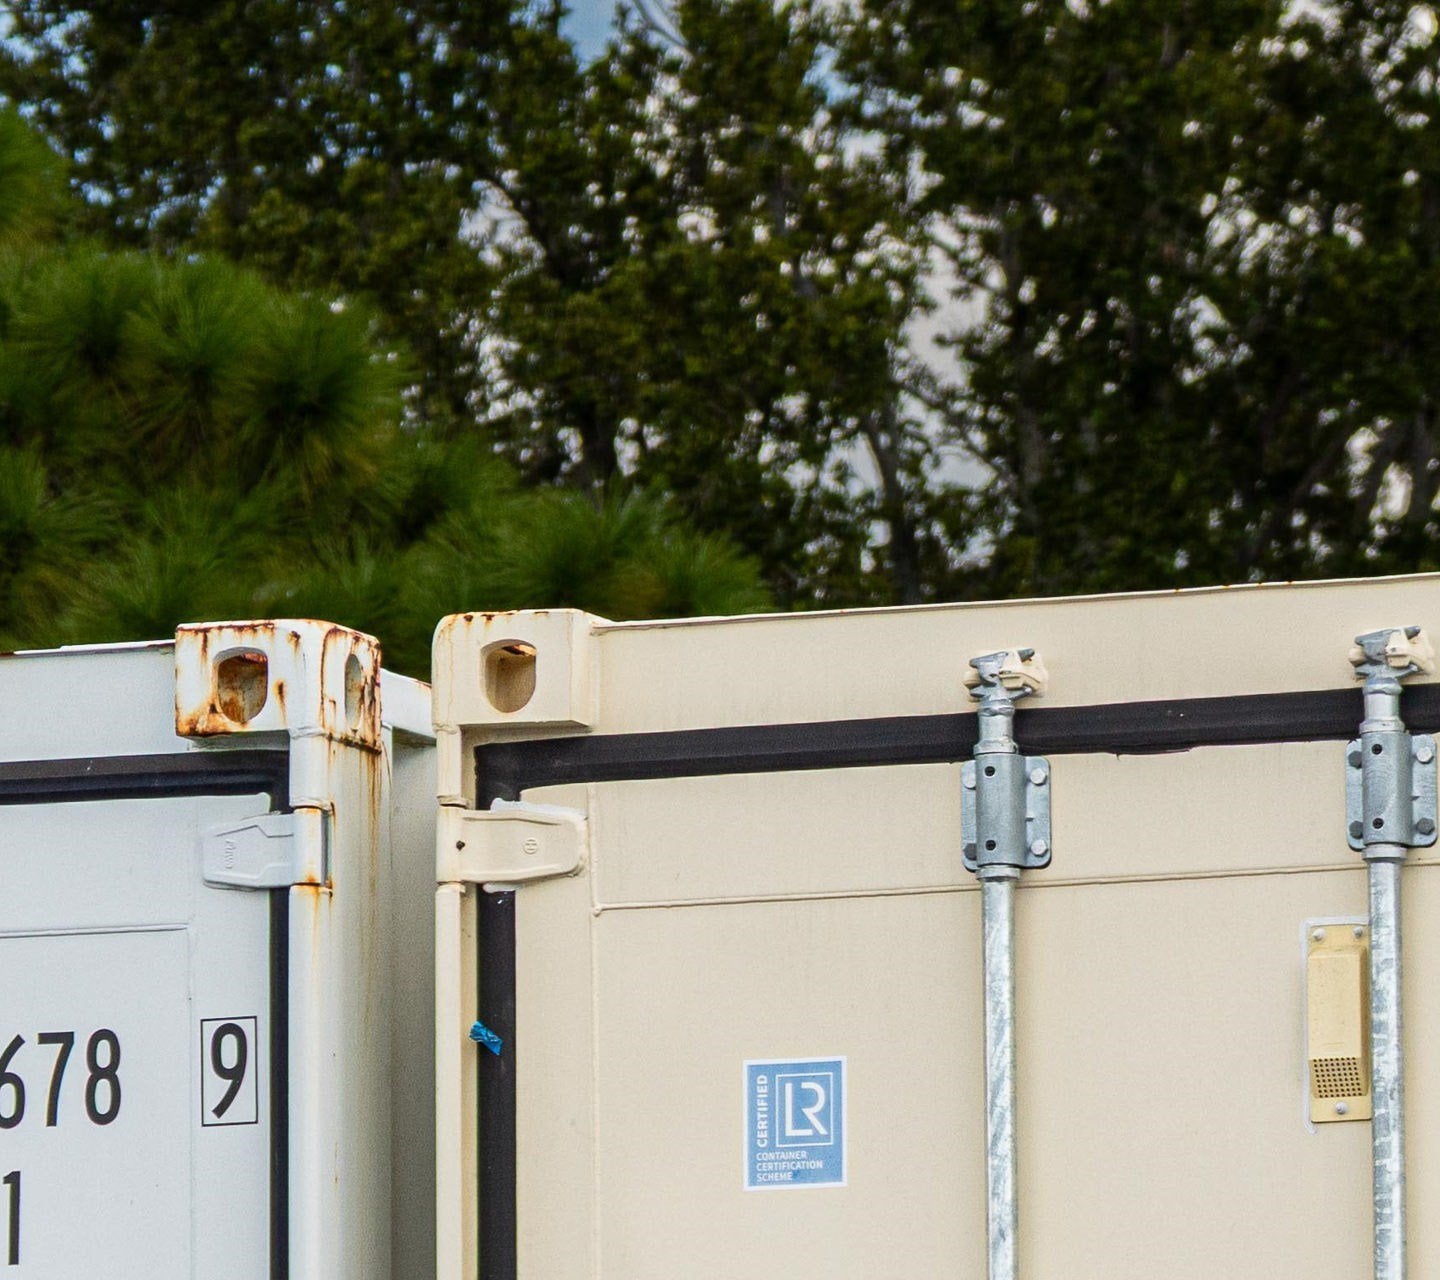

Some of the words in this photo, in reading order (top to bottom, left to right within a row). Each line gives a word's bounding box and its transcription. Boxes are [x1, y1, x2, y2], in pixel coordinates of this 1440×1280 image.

[211, 1022, 248, 1118] 9
[756, 1075, 768, 1147] CERTIFIED
[785, 1081, 828, 1136] LR
[756, 1151, 808, 1161] CONTAINER
[756, 1160, 823, 1171] CERTIFICATION
[756, 1171, 793, 1182] SCHEME
